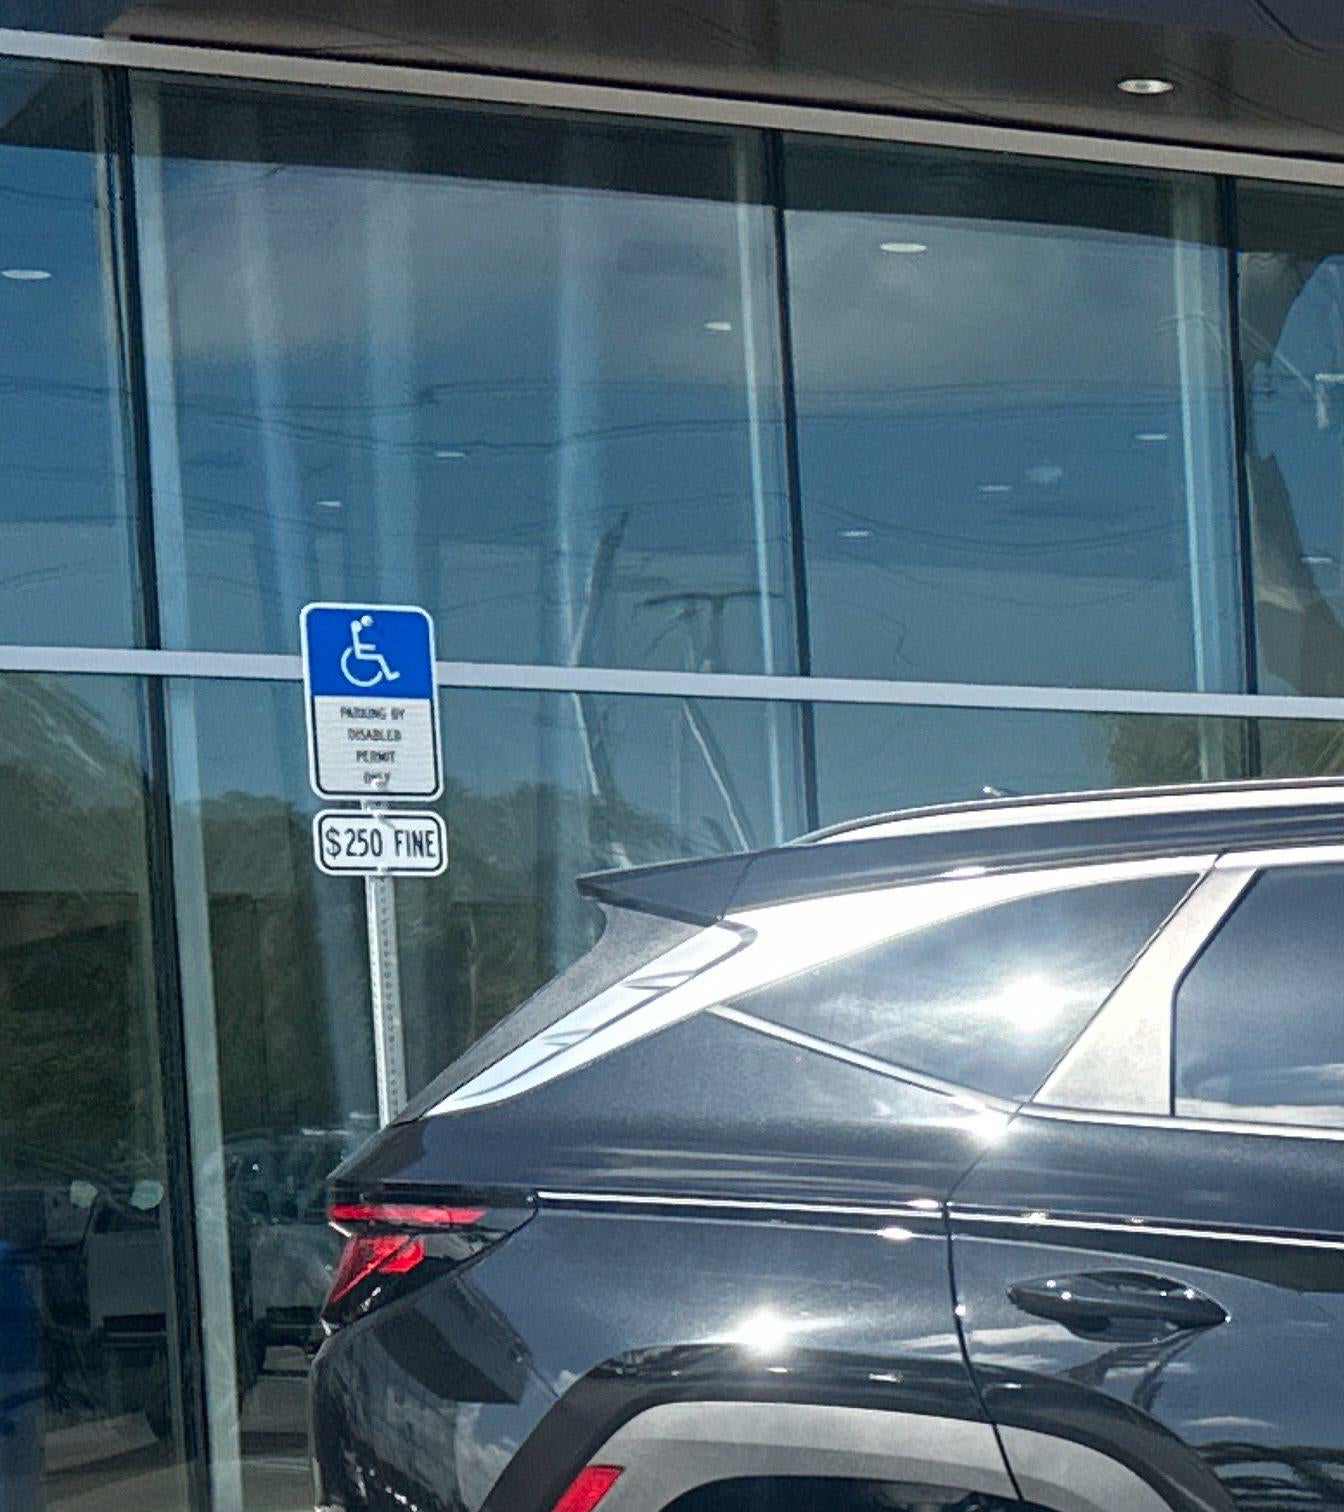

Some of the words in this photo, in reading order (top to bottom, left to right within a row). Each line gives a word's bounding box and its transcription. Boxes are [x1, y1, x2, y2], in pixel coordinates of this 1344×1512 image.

[340, 706, 386, 720] PARKING
[391, 708, 405, 720] BY
[347, 728, 402, 741] DISABLED
[356, 750, 395, 763] PERMIT
[325, 826, 383, 860] $250
[395, 830, 436, 858] FINE
